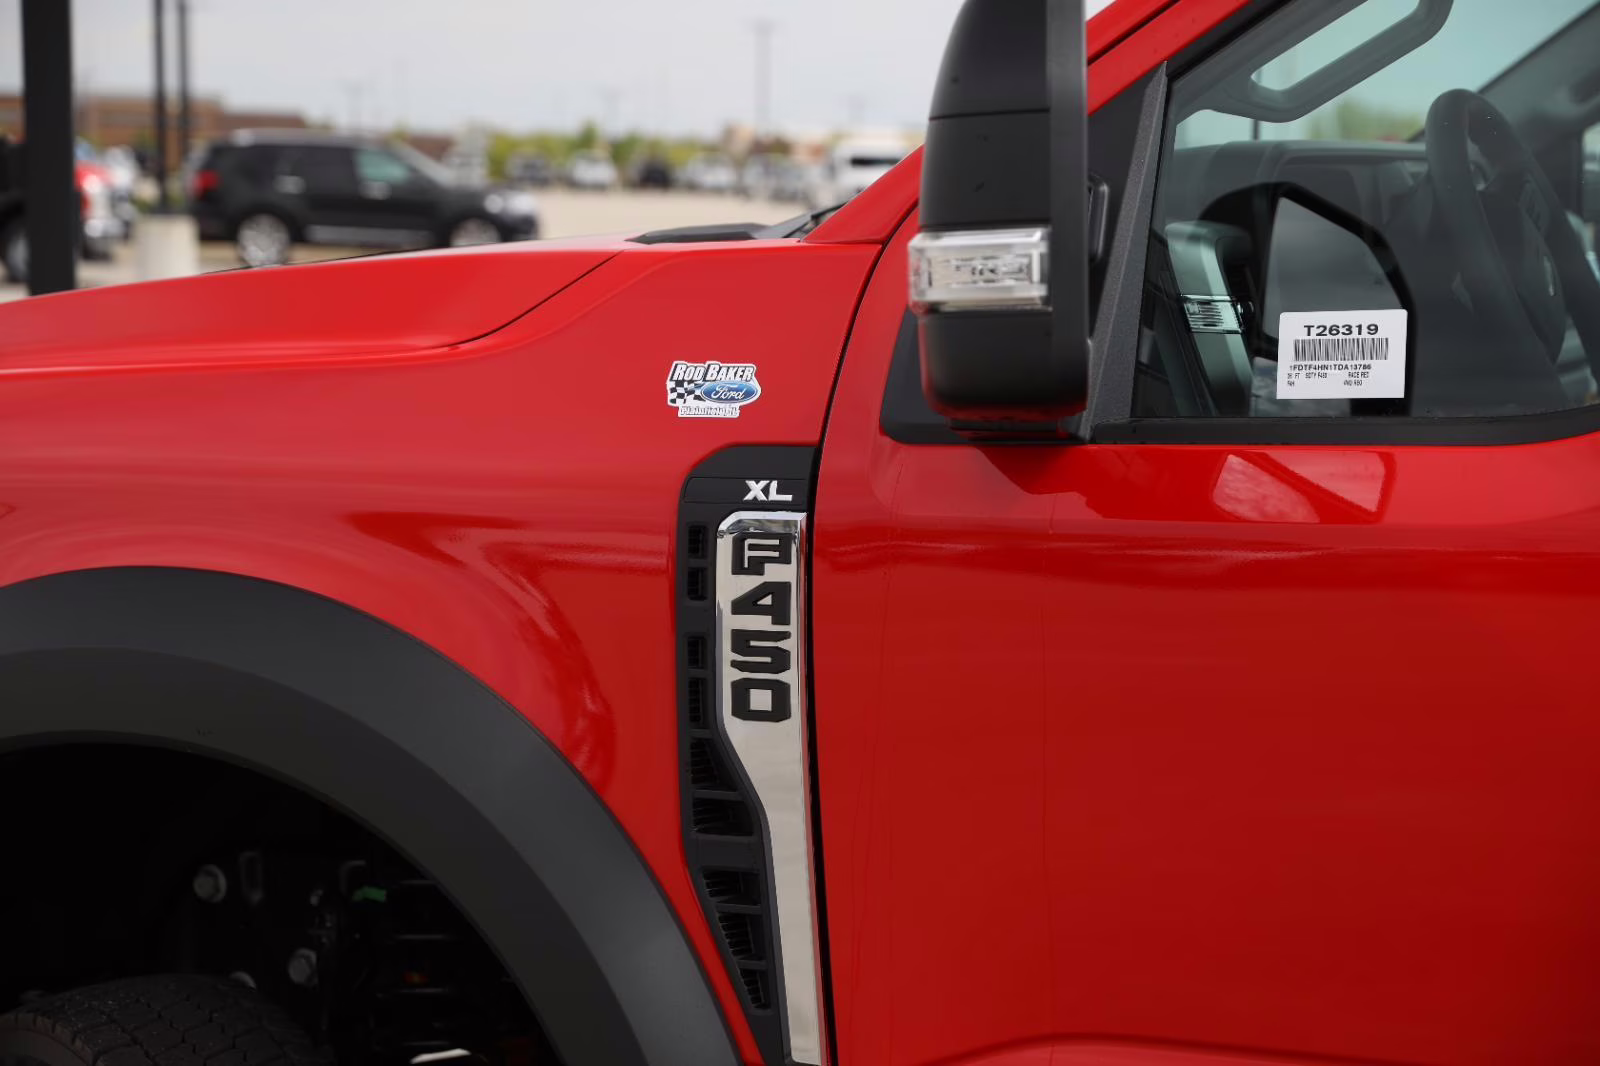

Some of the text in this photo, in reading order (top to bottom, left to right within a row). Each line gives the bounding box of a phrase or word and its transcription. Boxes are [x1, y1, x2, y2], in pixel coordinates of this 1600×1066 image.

[1304, 324, 1379, 336] T26319
[703, 363, 754, 382] BAKER
[711, 384, 745, 400] Ford
[743, 480, 793, 501] XL
[731, 532, 792, 723] F450
